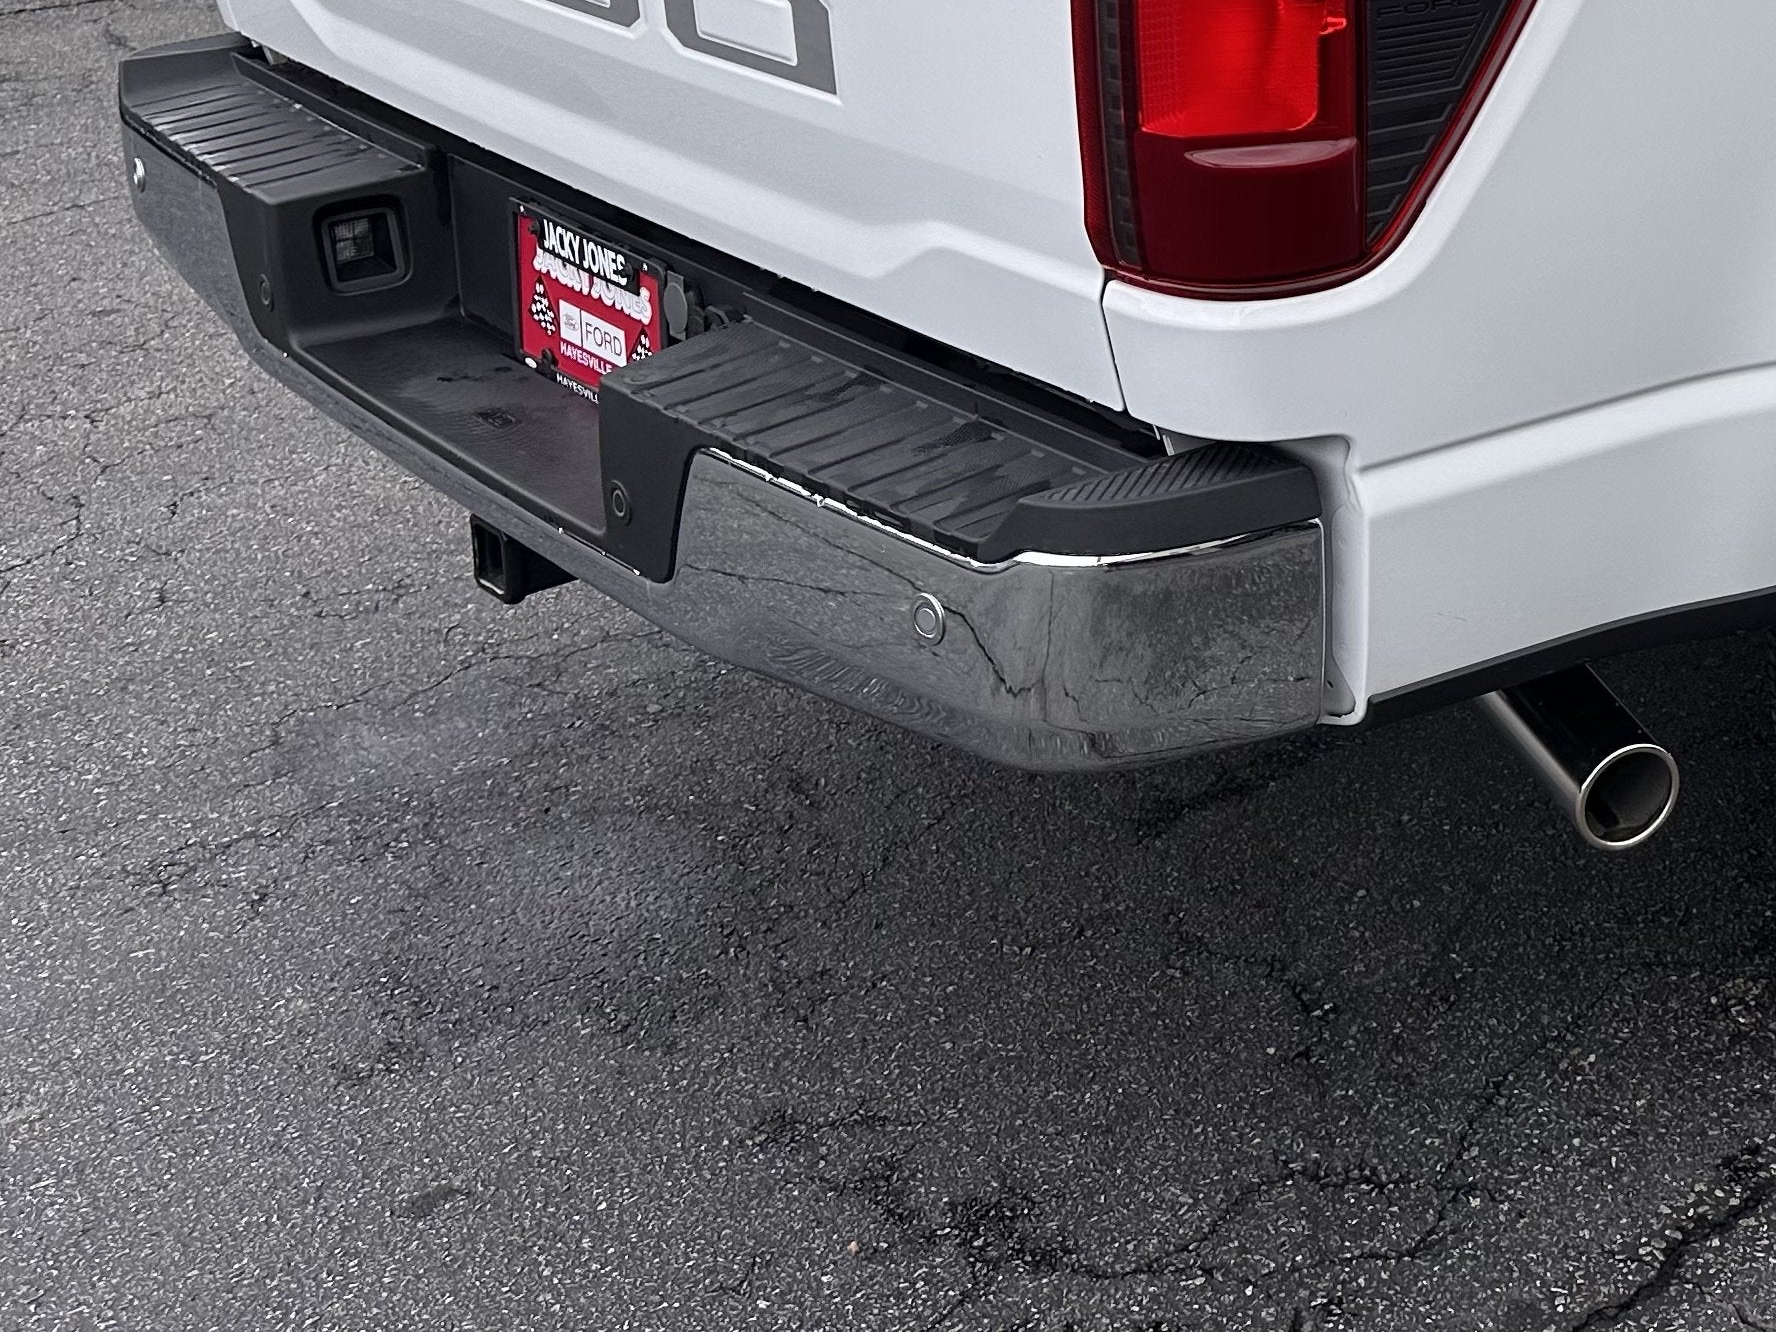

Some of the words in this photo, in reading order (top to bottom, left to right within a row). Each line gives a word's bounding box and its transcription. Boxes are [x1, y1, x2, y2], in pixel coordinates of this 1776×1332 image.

[543, 219, 580, 265] JACKY
[582, 239, 628, 286] JONES
[585, 321, 623, 358] FORD
[560, 341, 612, 375] HAYESVILLE
[556, 372, 600, 405] HAYESVILL
